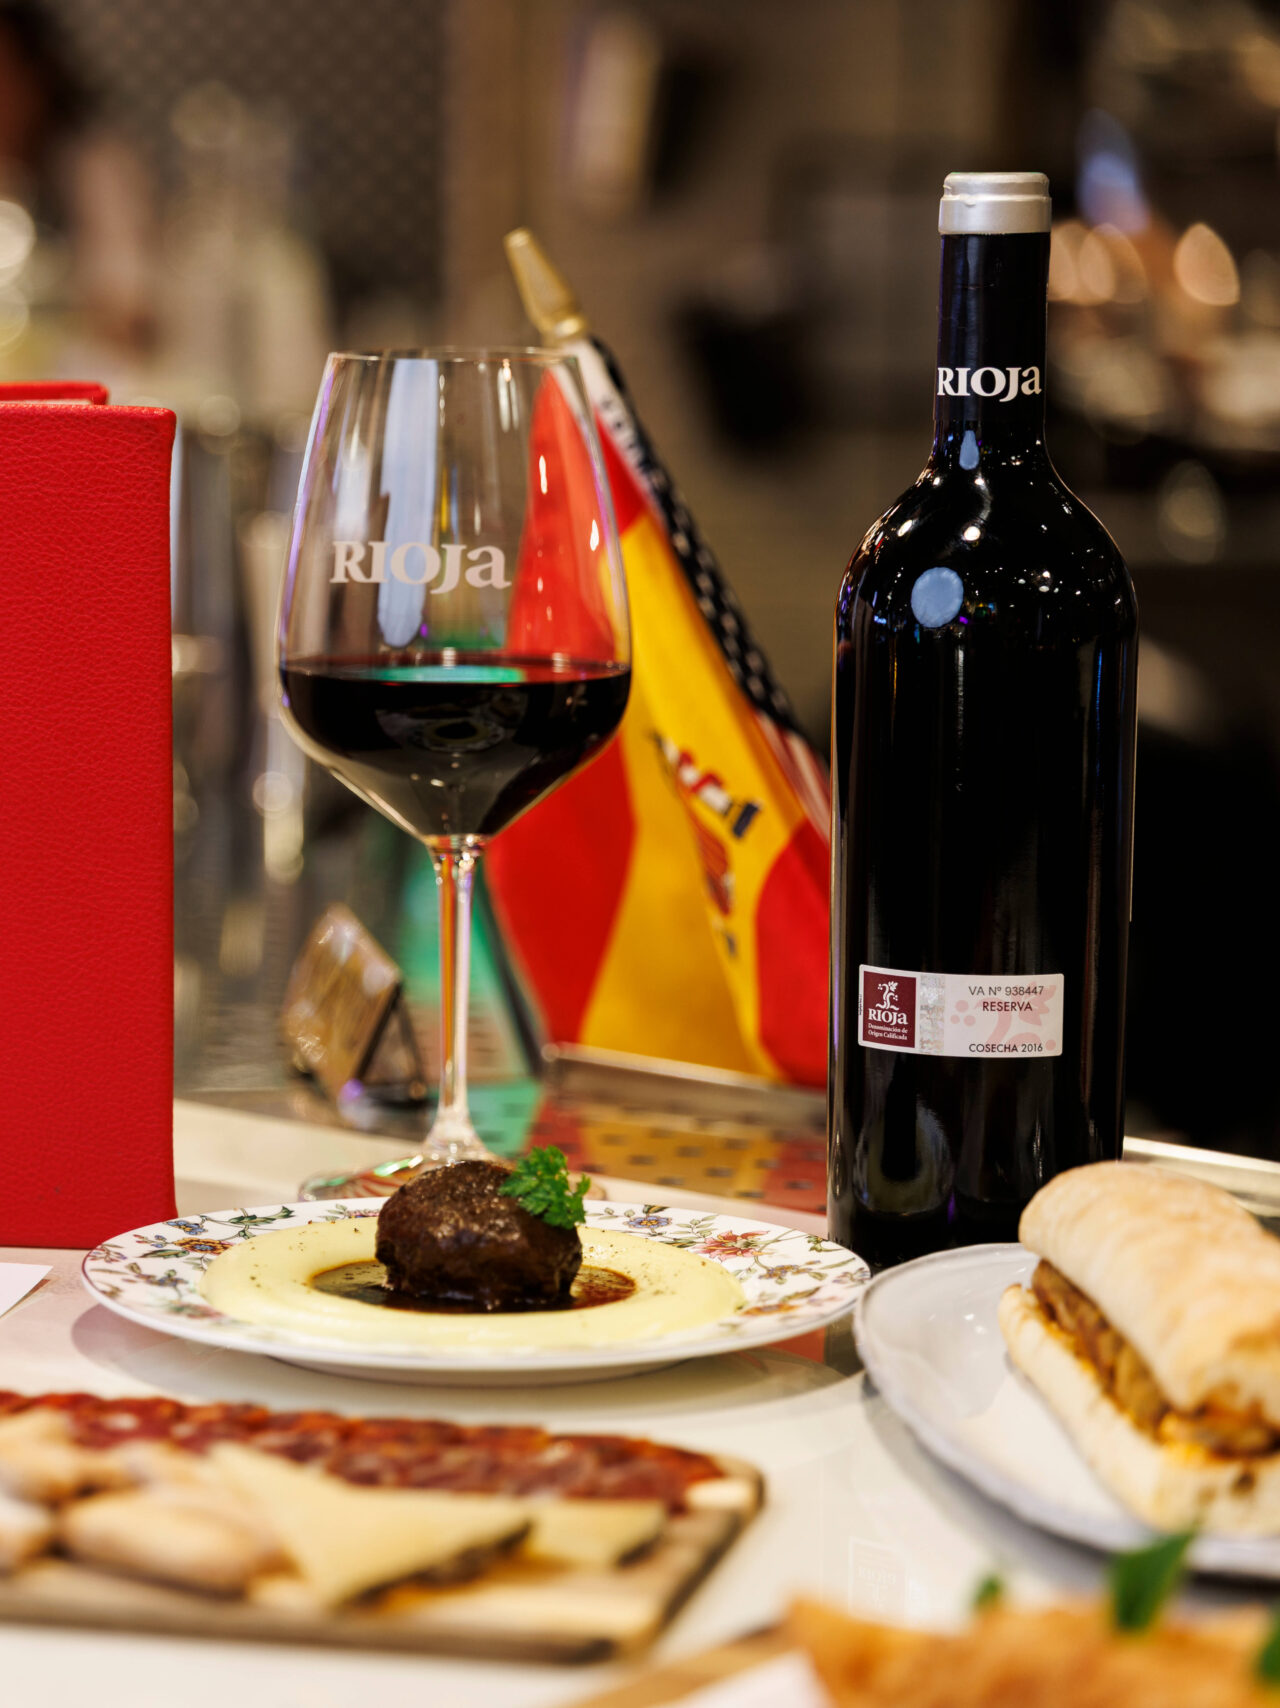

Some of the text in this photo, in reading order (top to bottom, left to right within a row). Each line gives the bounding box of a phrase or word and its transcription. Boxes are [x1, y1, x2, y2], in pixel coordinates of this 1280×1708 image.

[968, 986, 985, 996] VA
[1005, 985, 1045, 996] 938447
[982, 1001, 1033, 1012] RESERVA
[868, 1022, 901, 1033] Denominación
[868, 1029, 908, 1040] Origen Calificada
[968, 1042, 1044, 1053] COSECHA 2016
